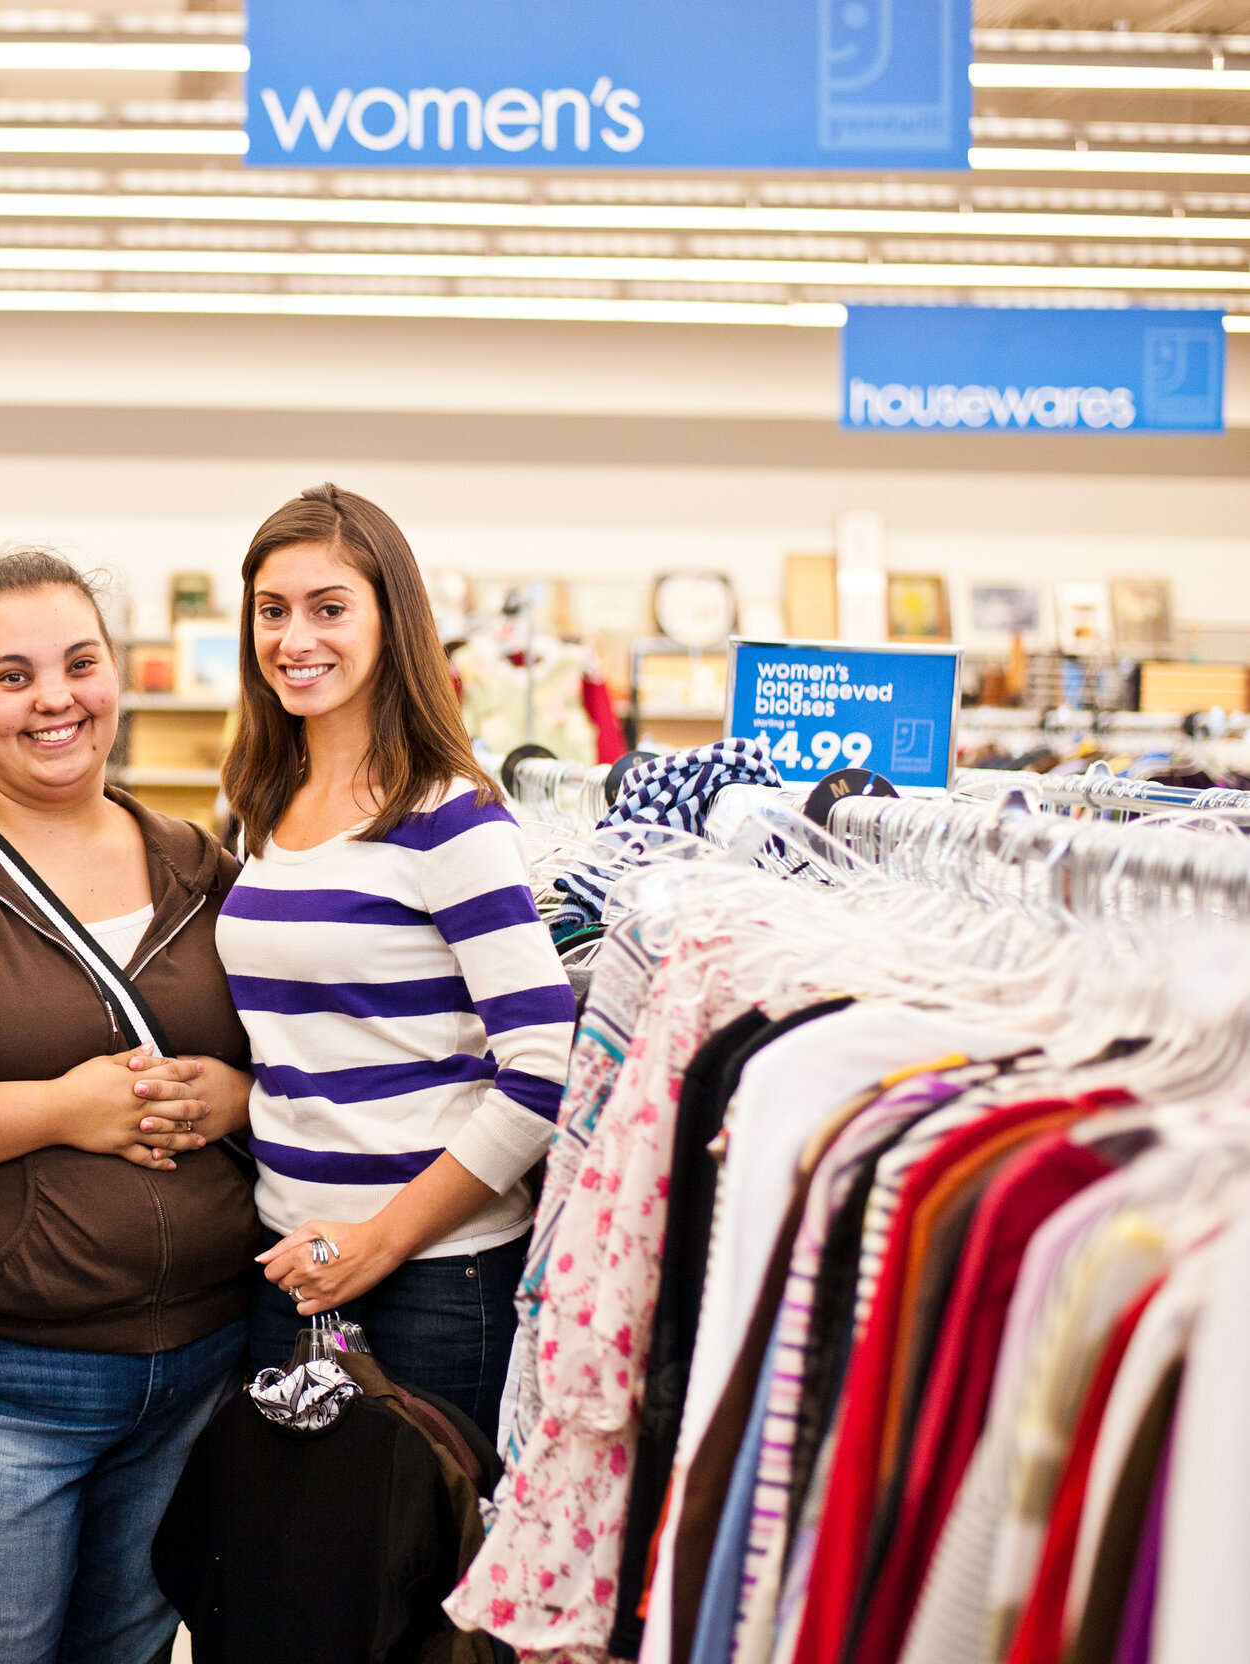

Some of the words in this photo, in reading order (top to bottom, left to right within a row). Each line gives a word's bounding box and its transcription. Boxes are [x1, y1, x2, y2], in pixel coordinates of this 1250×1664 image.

[260, 75, 644, 153] women's
[850, 376, 1136, 428] housewares
[757, 662, 849, 682] women's
[756, 677, 893, 702] long-sleeved
[755, 695, 835, 717] blouses
[829, 778, 850, 799] M
